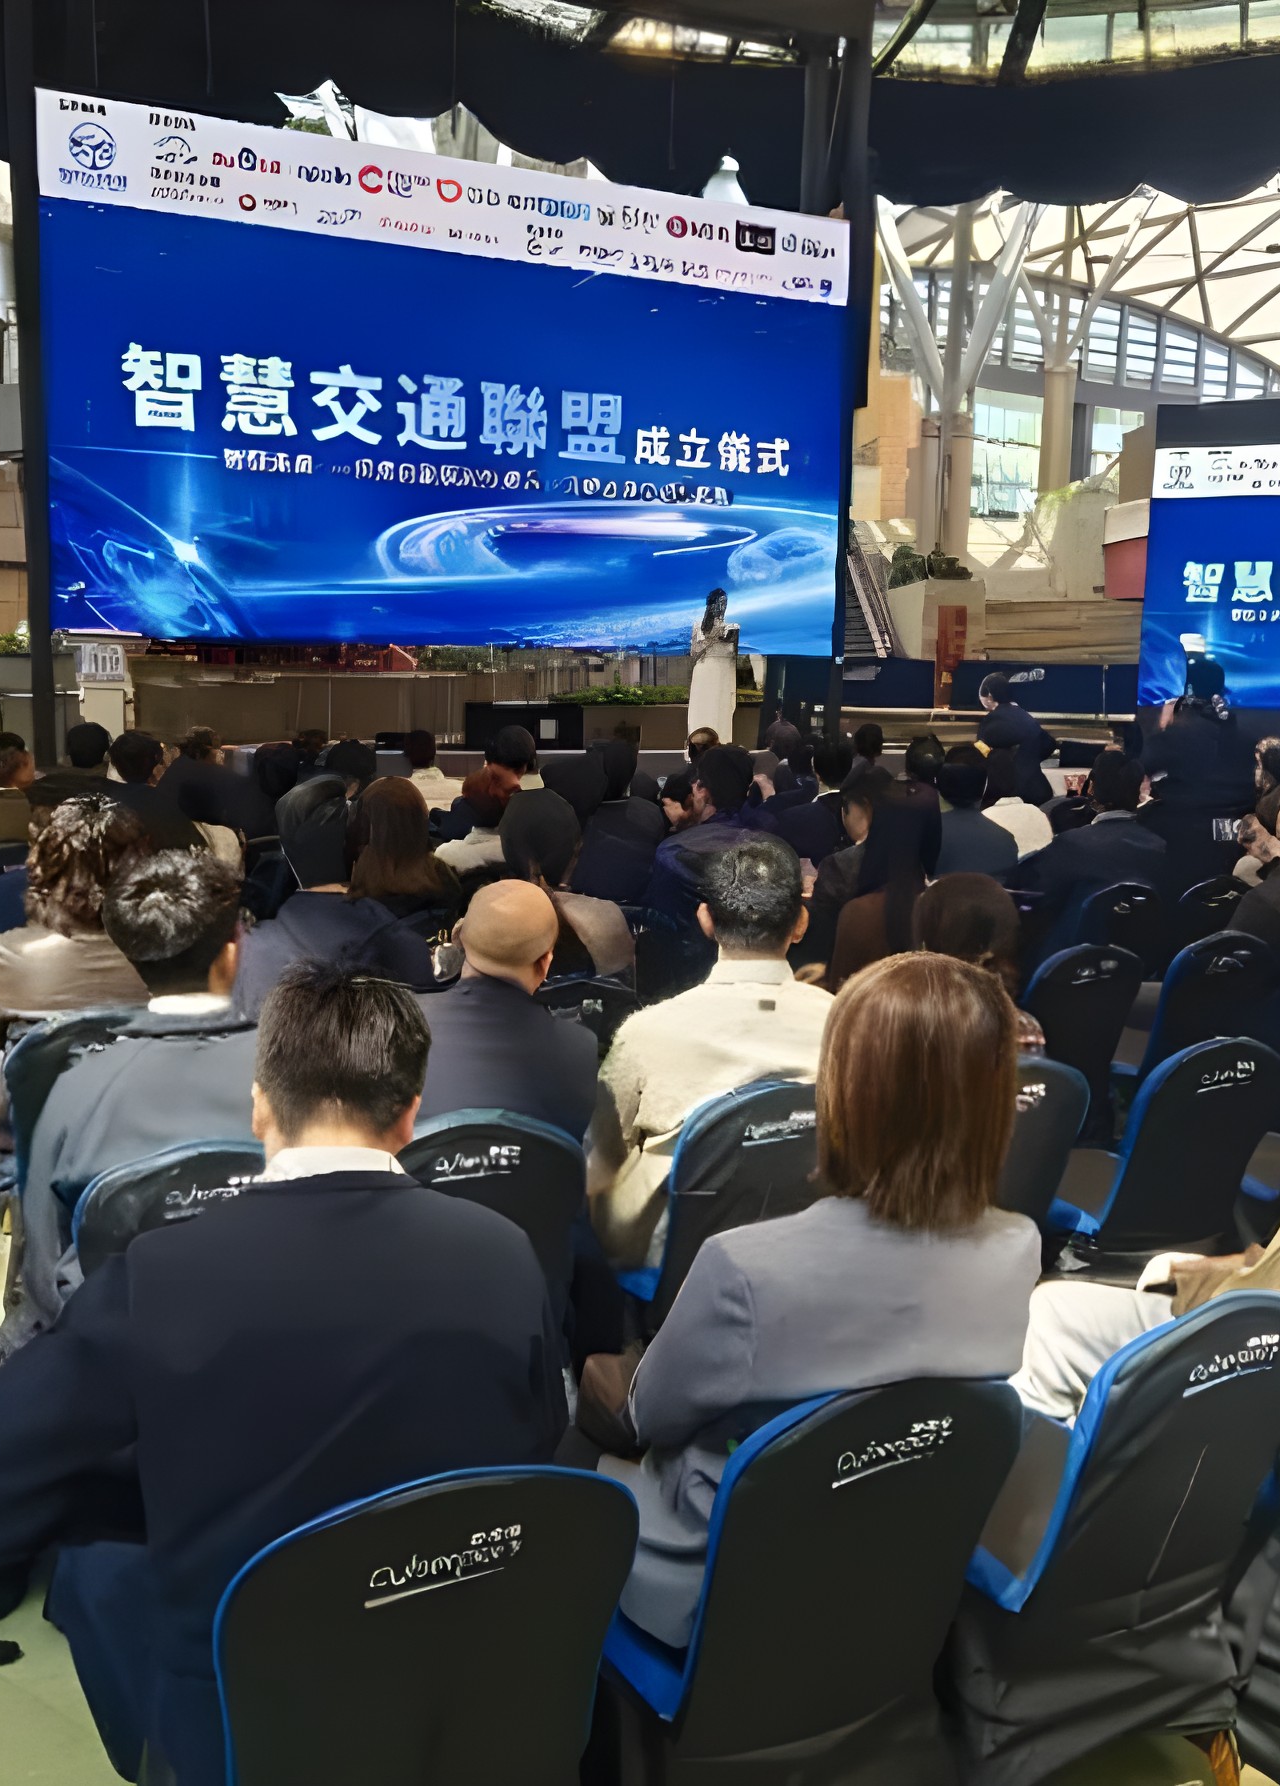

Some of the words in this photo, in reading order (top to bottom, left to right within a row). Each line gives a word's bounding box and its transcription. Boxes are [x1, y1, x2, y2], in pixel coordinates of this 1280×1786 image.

[120, 342, 627, 464] 智慧交通聯盟
